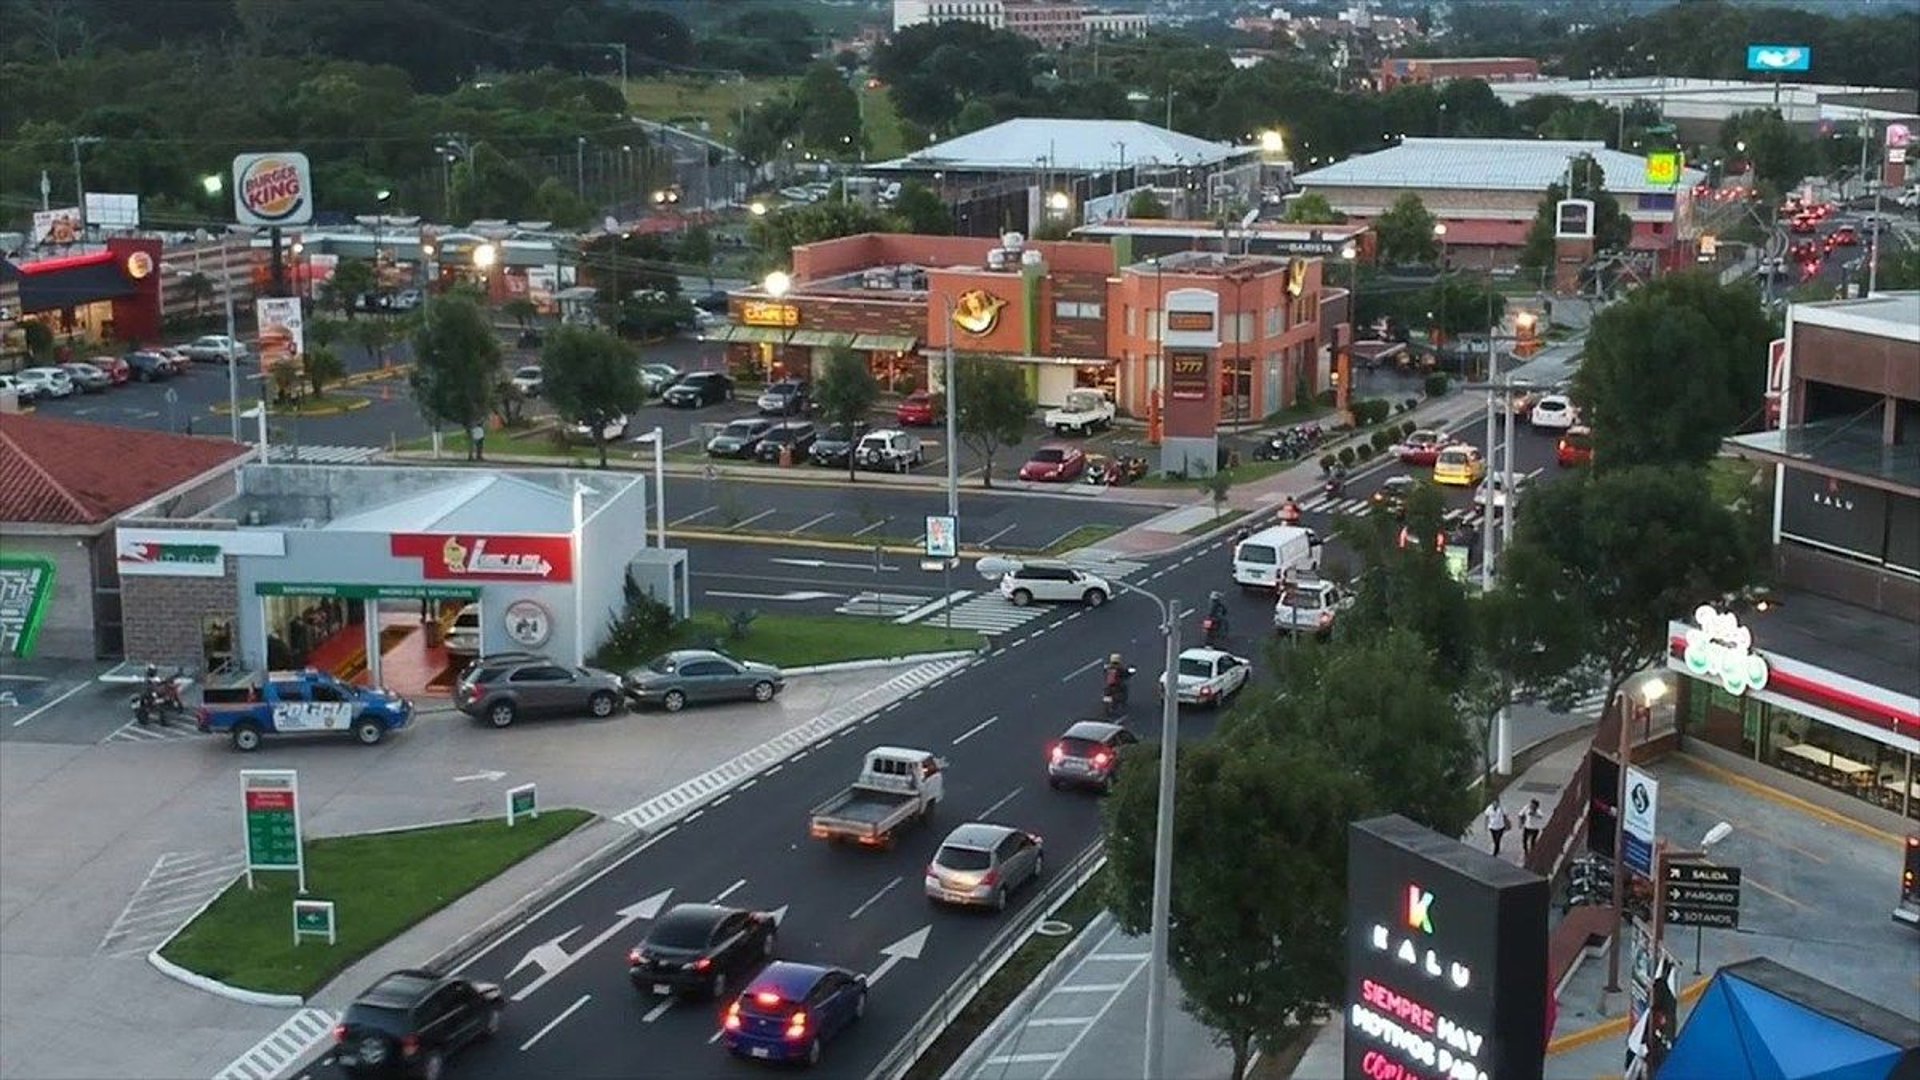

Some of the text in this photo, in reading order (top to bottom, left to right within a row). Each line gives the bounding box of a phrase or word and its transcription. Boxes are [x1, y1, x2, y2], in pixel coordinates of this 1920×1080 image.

[246, 166, 297, 194] BURGER
[249, 179, 300, 209] KING
[1692, 868, 1729, 881] SALIDA
[1684, 888, 1734, 902] PARQUEO
[1373, 924, 1470, 988] KALU
[1363, 979, 1483, 1057] SIEMPRE HAY
[1352, 1003, 1436, 1067] MOTIVOS
